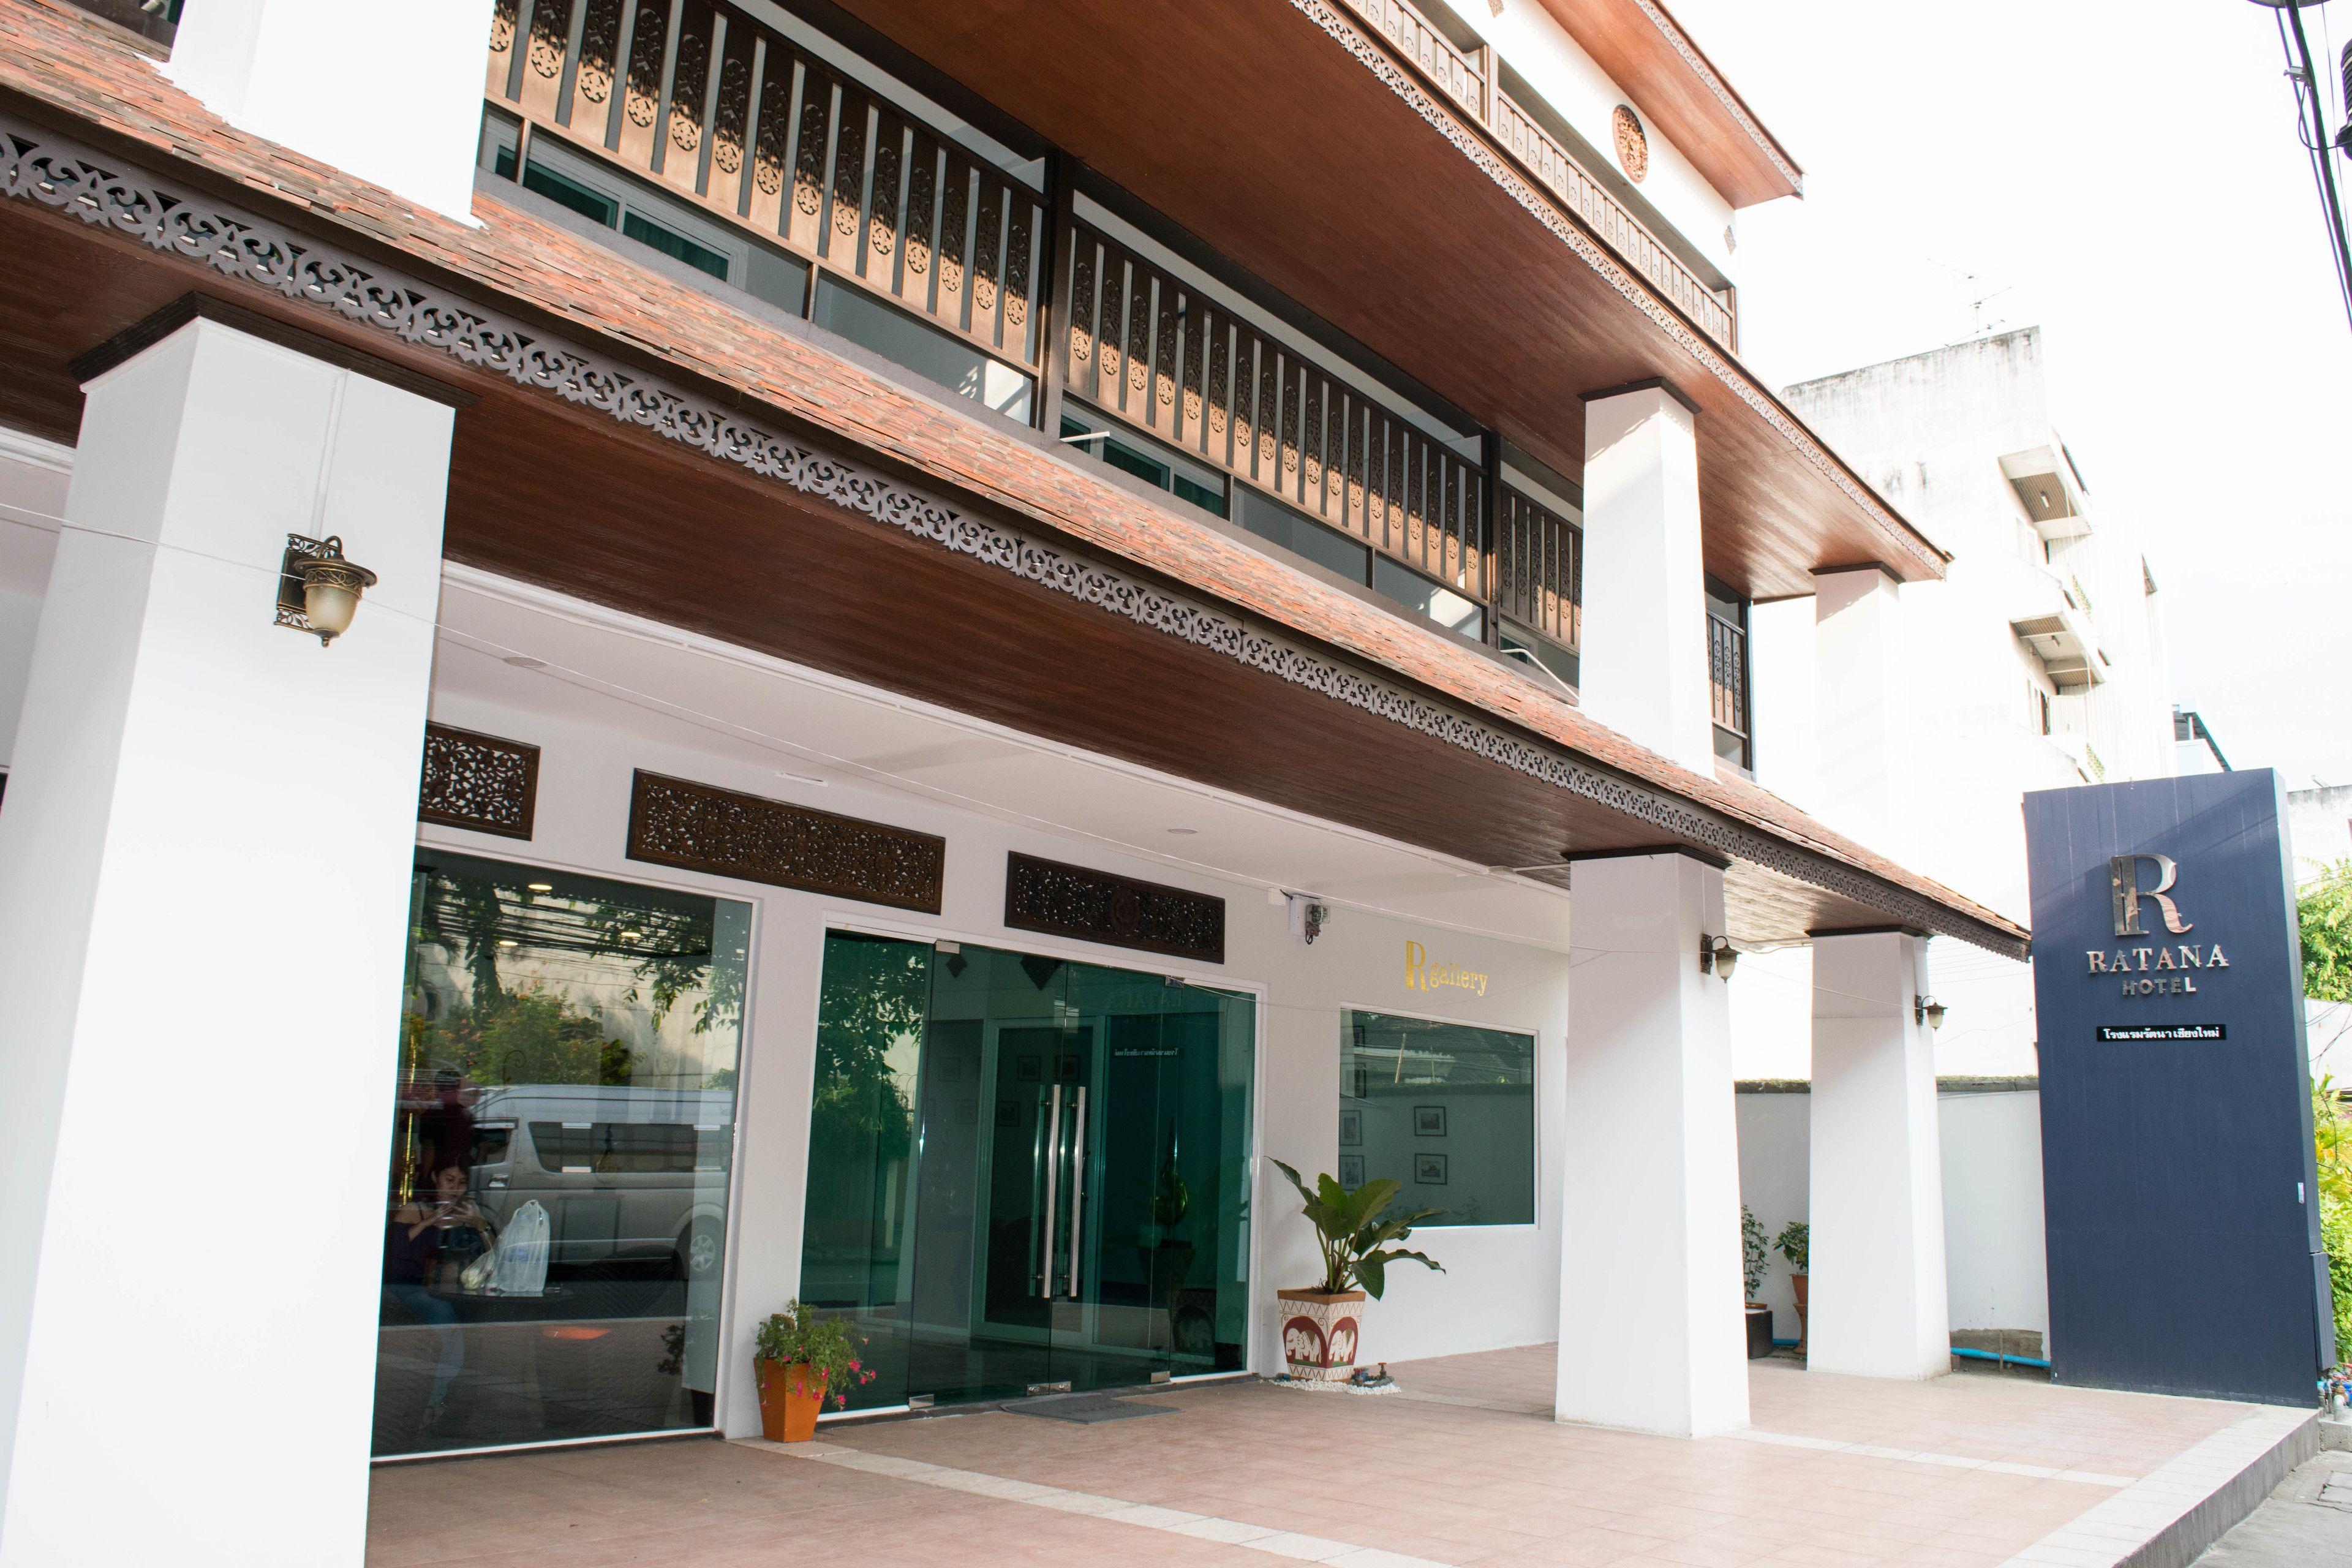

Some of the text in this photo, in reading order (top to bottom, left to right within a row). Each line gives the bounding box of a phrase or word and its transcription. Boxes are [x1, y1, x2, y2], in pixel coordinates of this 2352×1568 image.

[2111, 853, 2193, 935] R
[1406, 940, 1488, 996] R gallery
[2087, 944, 2230, 973] RATANA
[2122, 977, 2196, 995] HOTEL
